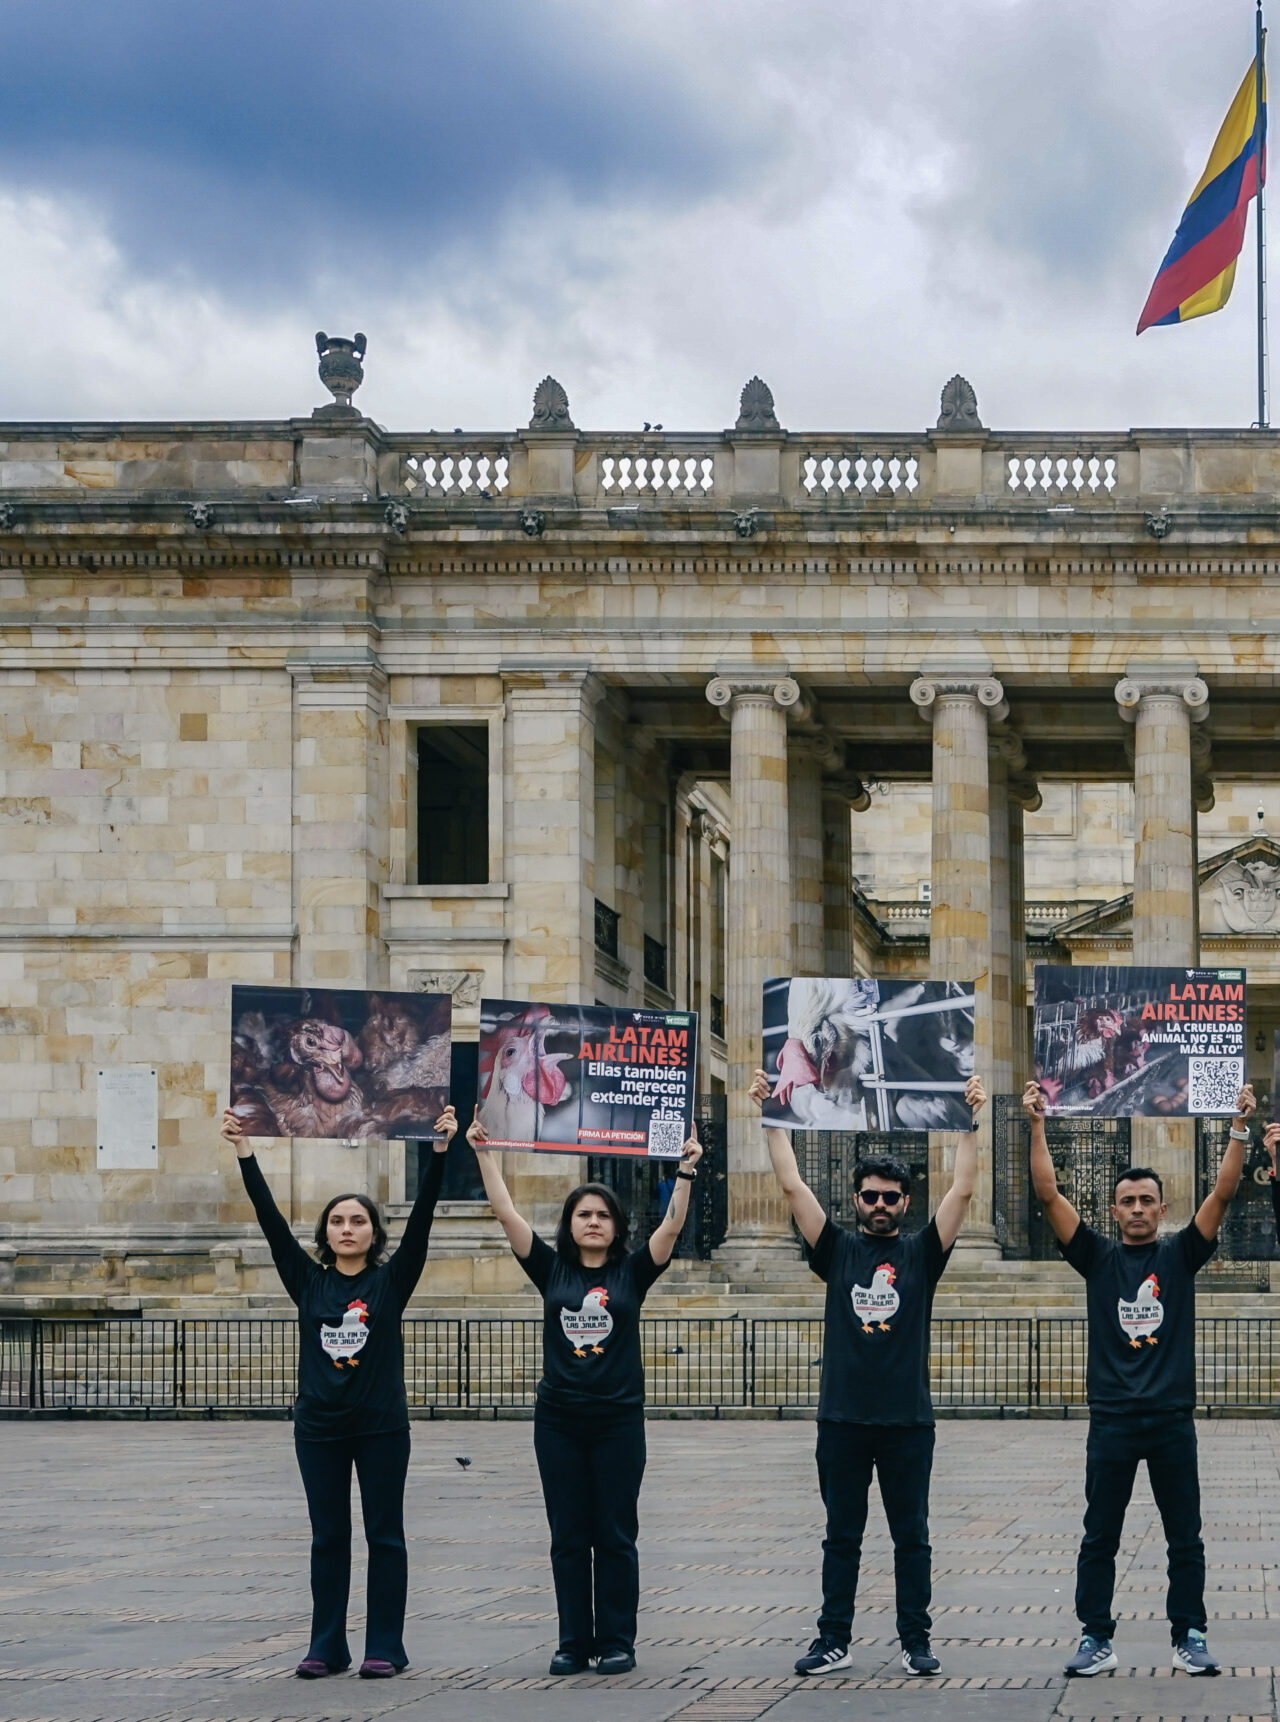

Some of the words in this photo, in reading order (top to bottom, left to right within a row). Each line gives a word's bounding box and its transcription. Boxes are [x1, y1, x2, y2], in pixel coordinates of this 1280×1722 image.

[1170, 984, 1243, 1000] LATAM
[1142, 1004, 1244, 1021] AIRLINES:
[1167, 1023, 1181, 1032] LA
[1184, 1023, 1243, 1033] CRUELDAD
[609, 1026, 688, 1048] LATAM
[1142, 1034, 1187, 1043] ANIMAL
[1190, 1034, 1208, 1043] NO
[1211, 1034, 1223, 1043] ES
[578, 1042, 687, 1066] AIRLINES:
[1180, 1042, 1205, 1054] MÁS
[589, 1062, 621, 1077] Ellas
[624, 1066, 686, 1081] también
[621, 1080, 686, 1094] merecen
[591, 1091, 656, 1106] extender
[660, 1096, 685, 1108] sus
[651, 1107, 684, 1121] alas.
[579, 1130, 600, 1138] FIRMA
[611, 1130, 644, 1140] PETICIÓN
